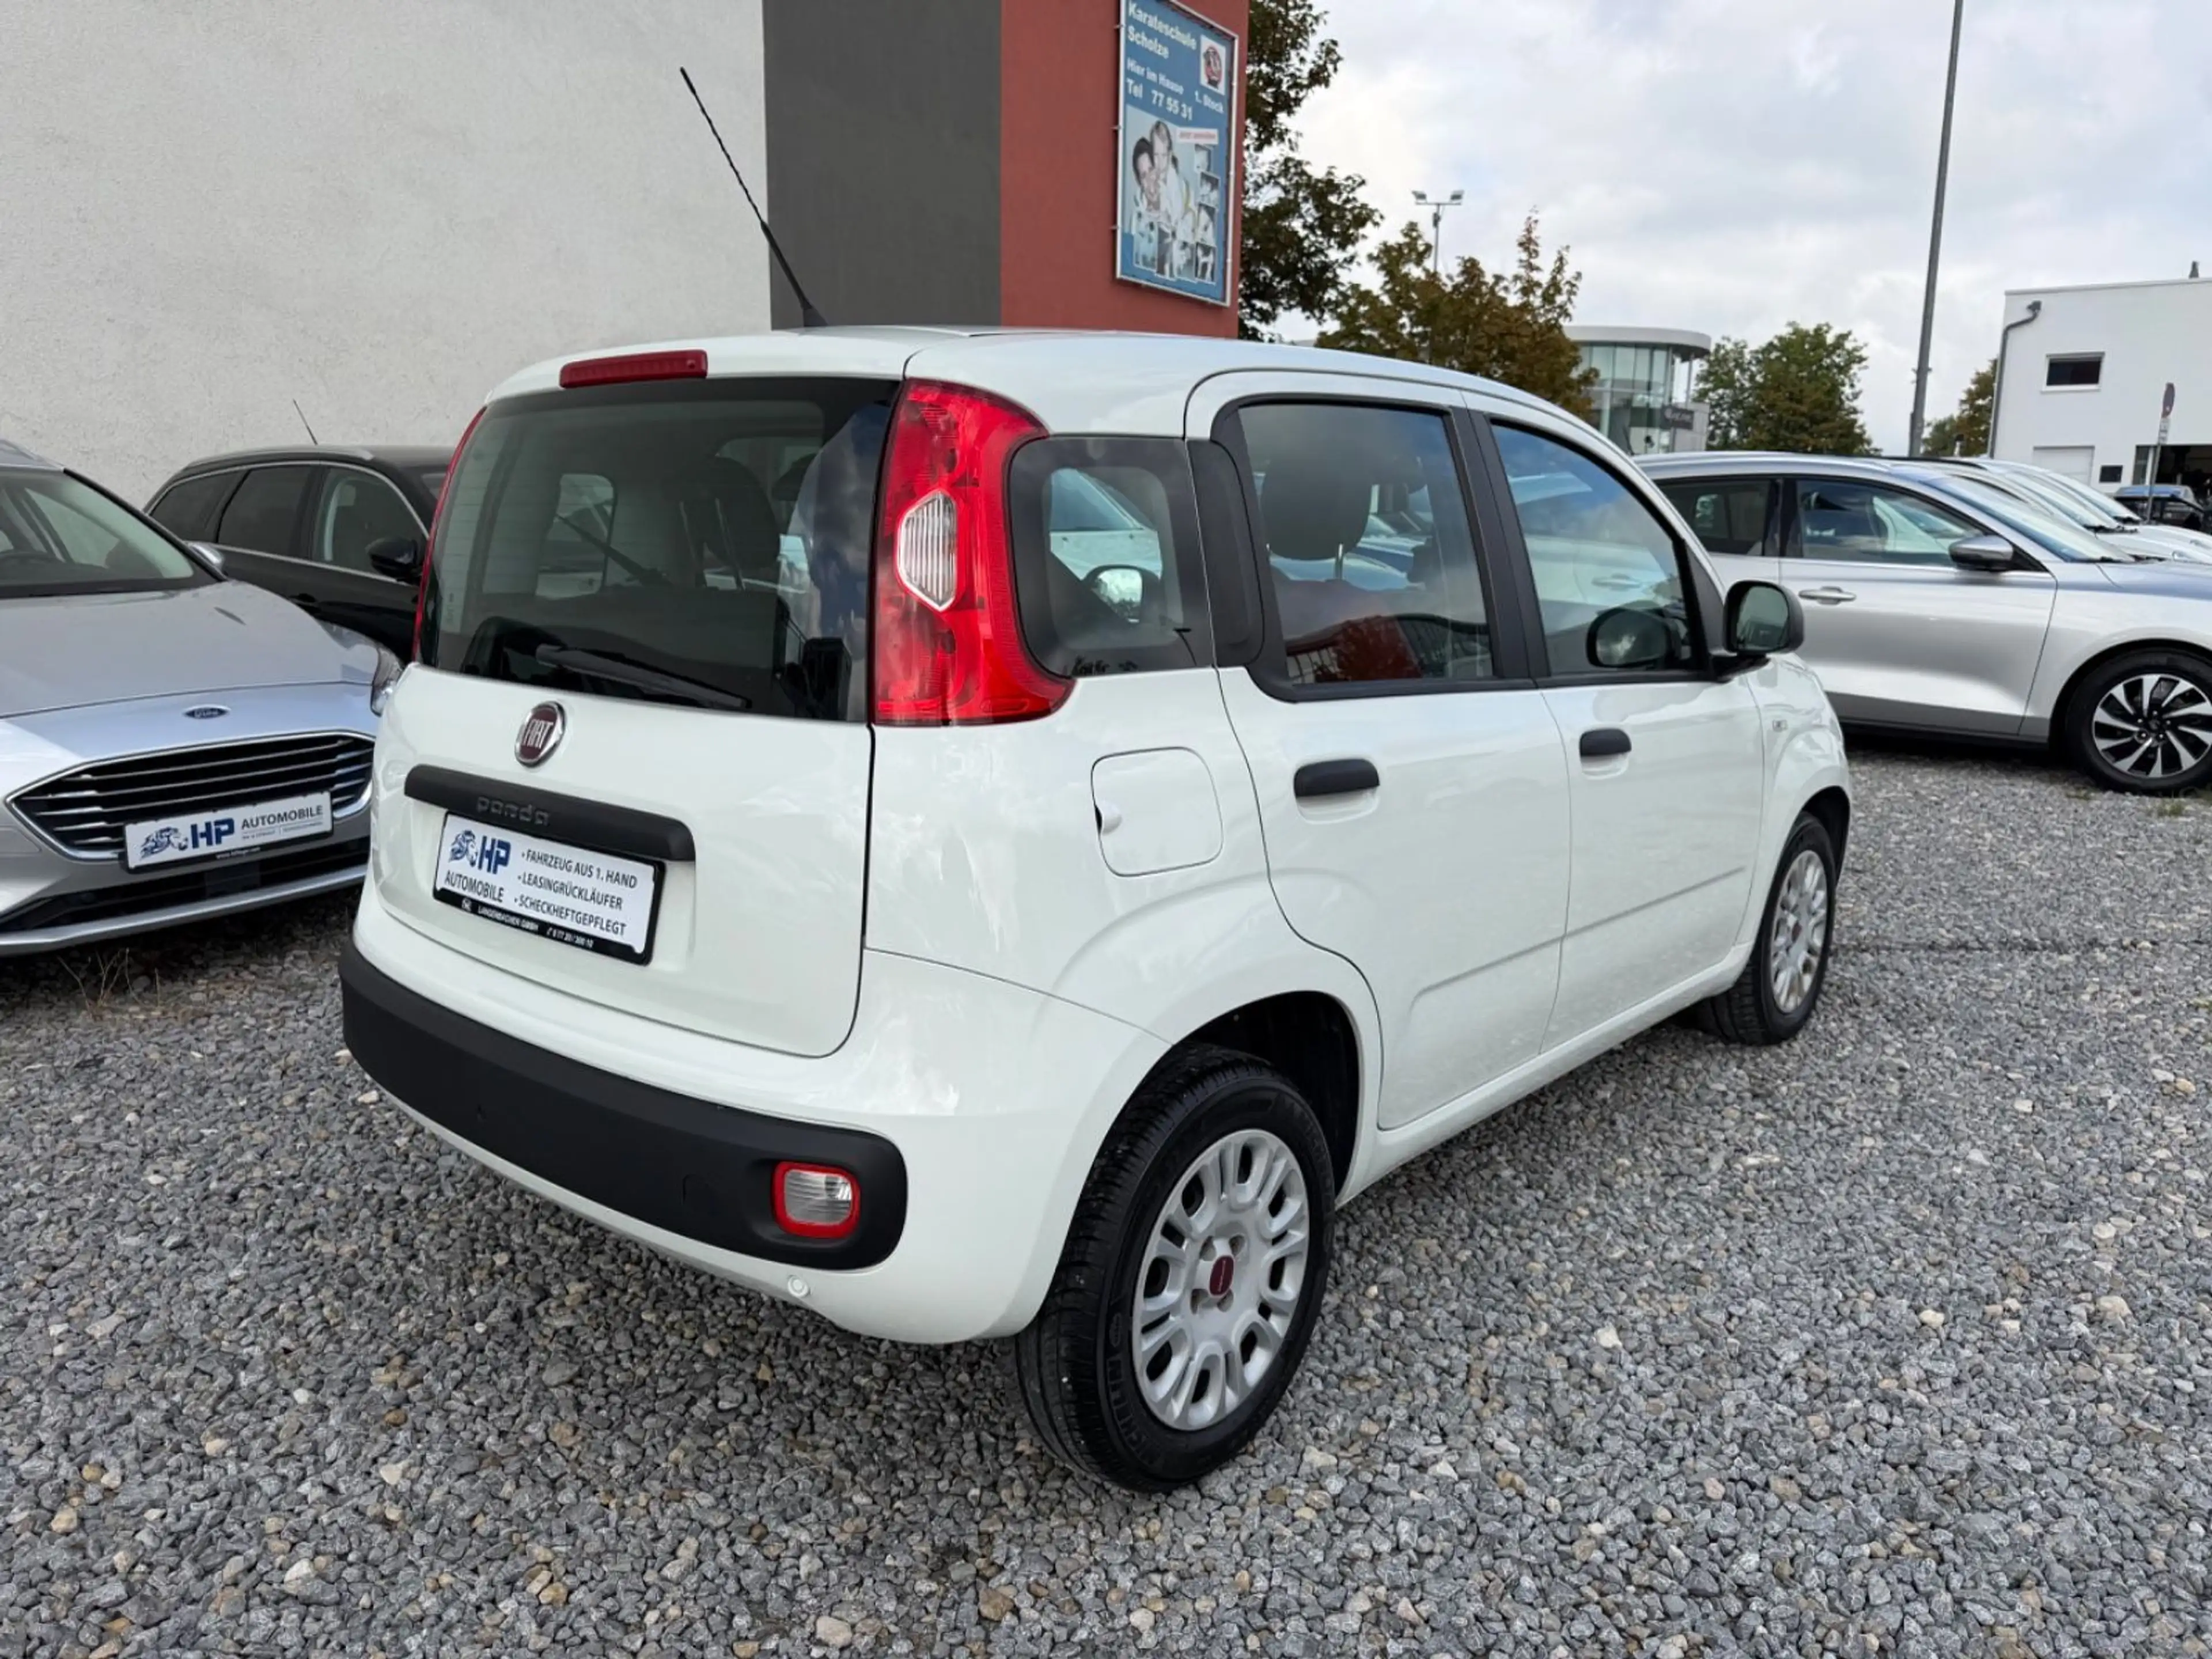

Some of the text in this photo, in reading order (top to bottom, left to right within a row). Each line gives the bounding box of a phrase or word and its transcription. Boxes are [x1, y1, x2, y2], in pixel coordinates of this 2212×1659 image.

[1128, 1, 1196, 50] Karateschule
[1146, 66, 1157, 84] im
[1126, 78, 1143, 99] Tel
[1151, 89, 1165, 107] 77
[521, 718, 554, 749] FIAT
[190, 817, 234, 849] HP
[241, 805, 323, 830] AUTOMOBILE
[477, 797, 550, 826] panda
[478, 835, 511, 874] HP
[444, 870, 504, 903] AUTOMOBILE
[573, 862, 594, 878] AUS
[596, 868, 604, 881] 1.
[605, 869, 638, 889] HAND
